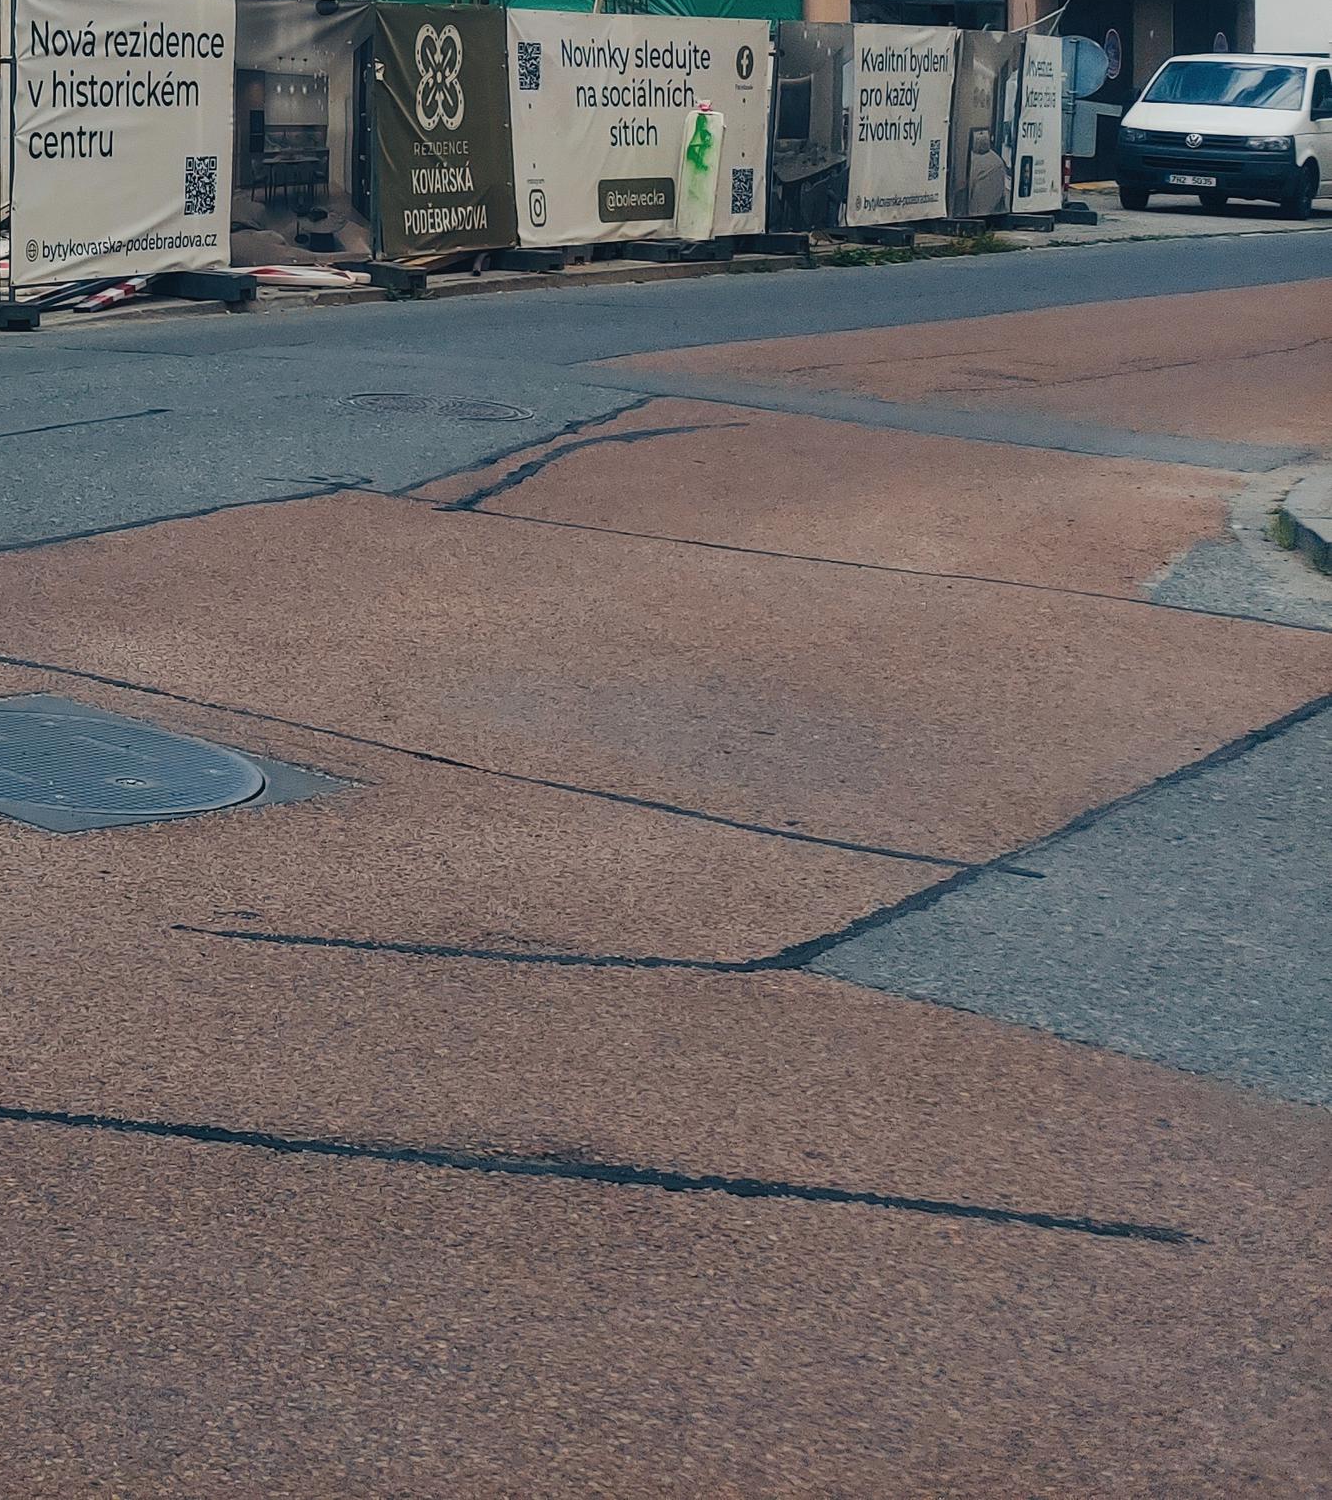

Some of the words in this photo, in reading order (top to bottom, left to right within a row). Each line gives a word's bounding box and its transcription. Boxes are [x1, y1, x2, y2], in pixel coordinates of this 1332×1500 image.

[31, 20, 96, 57] Nová
[105, 21, 224, 58] rezidence
[561, 38, 630, 75] Novinky
[635, 39, 711, 76] sledujte
[861, 46, 907, 73] Kvalitní
[910, 47, 949, 78] bydlení
[28, 80, 43, 107] v
[52, 70, 199, 108] historickém
[576, 86, 597, 107] na
[602, 78, 695, 108] sociálních
[860, 87, 882, 113] pro
[886, 80, 920, 112] každý
[28, 126, 113, 159] centru
[610, 117, 658, 146] sítích
[858, 116, 901, 142] životní
[903, 115, 923, 146] styl
[414, 141, 469, 156] REZIDENCE
[412, 160, 474, 194] KOVÁŘSKÁ
[606, 190, 665, 211] @bolevecka
[404, 202, 488, 235] PODĚBRADOVA
[42, 231, 217, 262] bytykovarska-podebradova.cz
